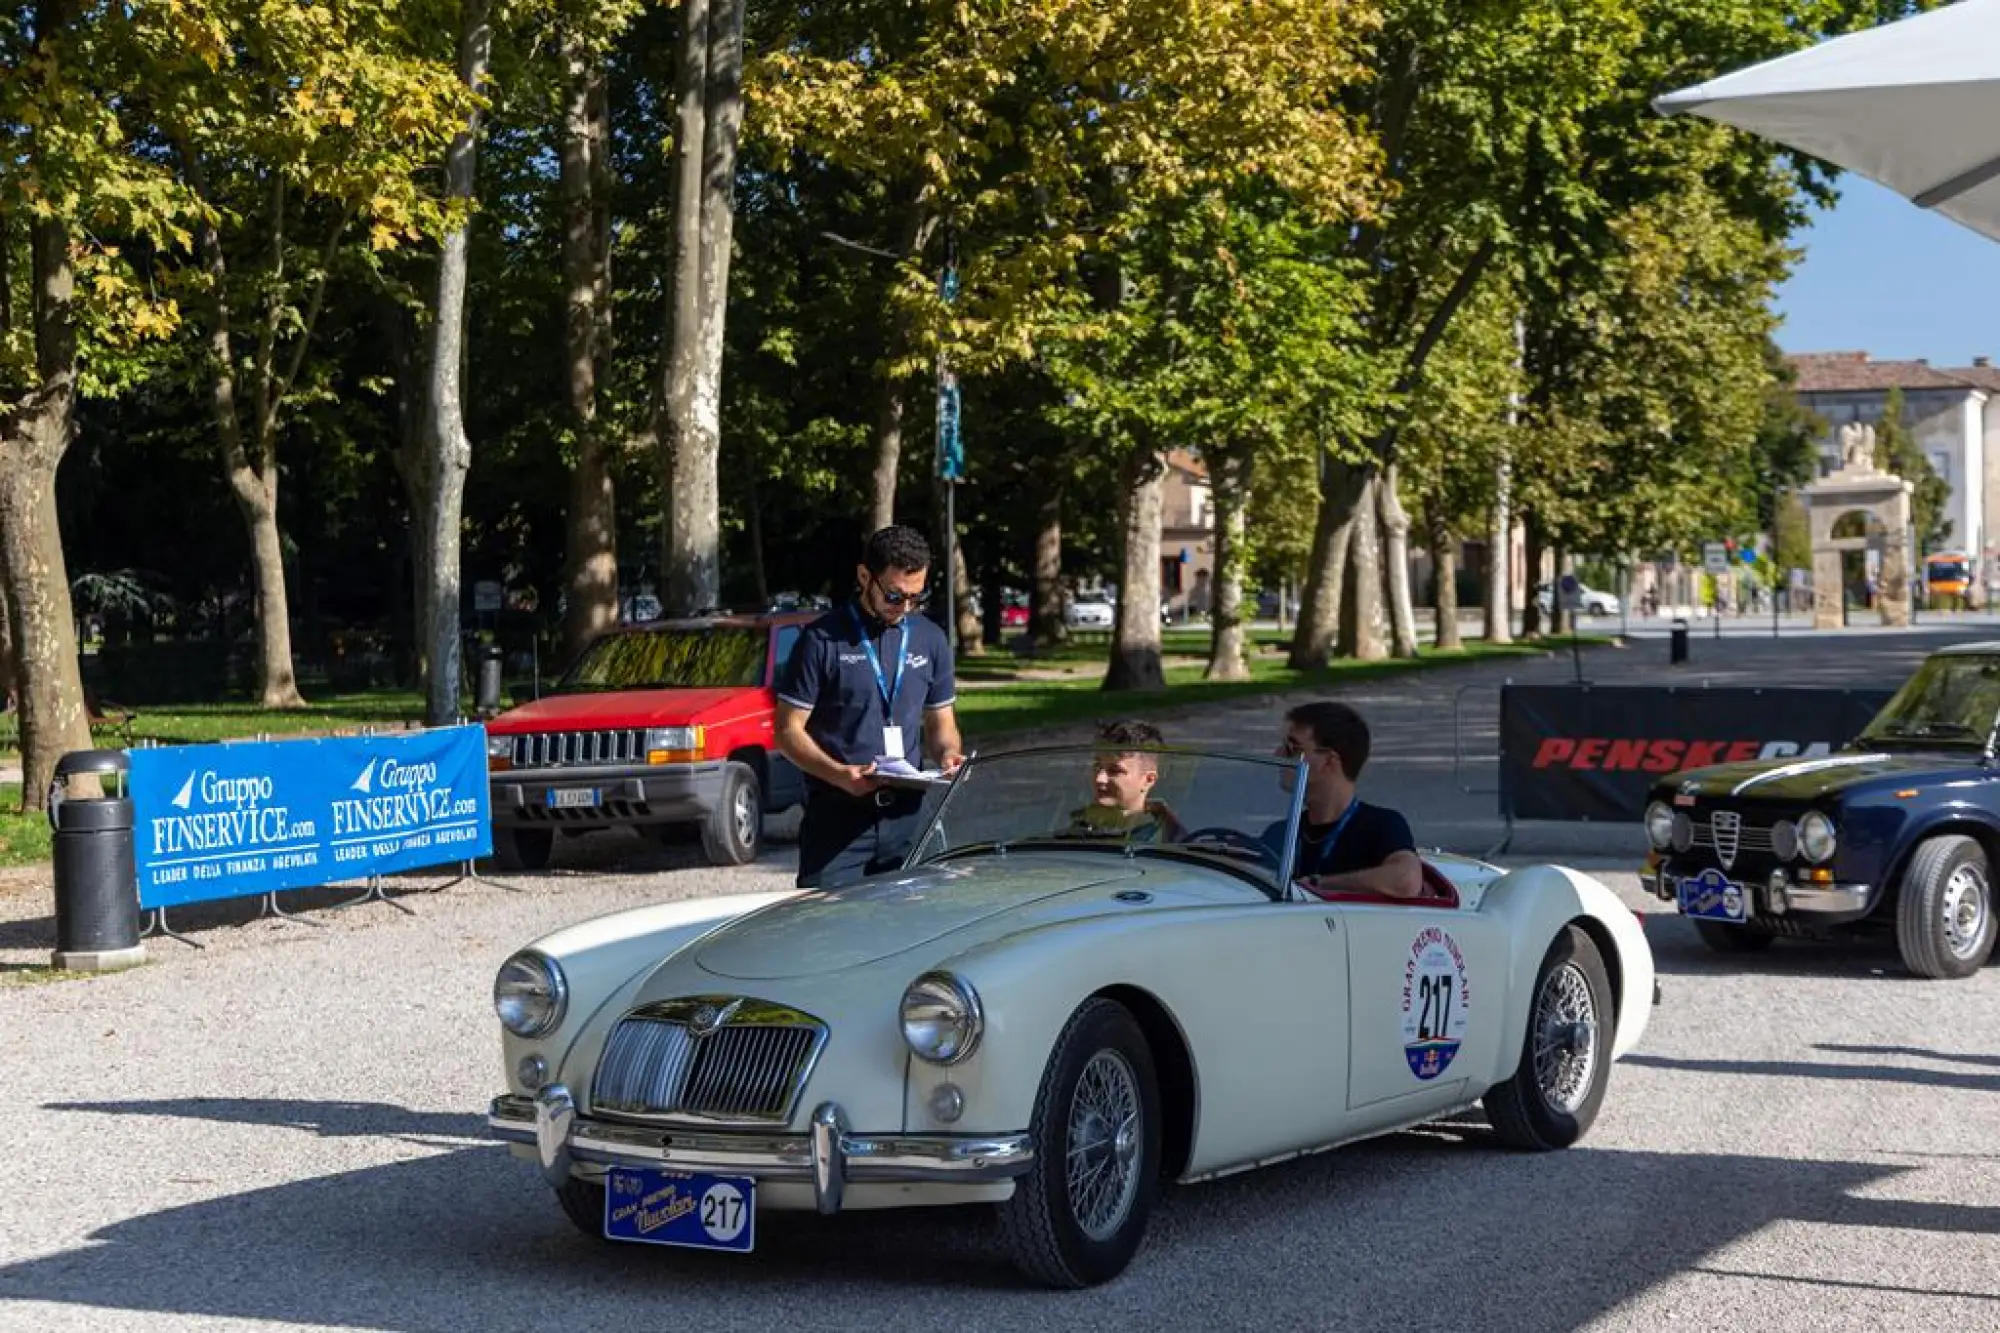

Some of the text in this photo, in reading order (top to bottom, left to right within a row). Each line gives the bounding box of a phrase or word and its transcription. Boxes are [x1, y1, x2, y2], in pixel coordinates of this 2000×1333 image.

[1533, 737, 1851, 772] PENSKEC
[201, 770, 273, 810] Gruppo
[380, 758, 437, 793] Gruppo
[331, 787, 476, 834] FINSERVICE.com
[151, 807, 316, 855] FINSERVICE.com
[152, 866, 187, 884] LEADER
[193, 863, 222, 879] DELLA
[227, 858, 266, 875] FINANZA
[1419, 975, 1452, 1038] 217
[703, 1193, 744, 1230] 217
